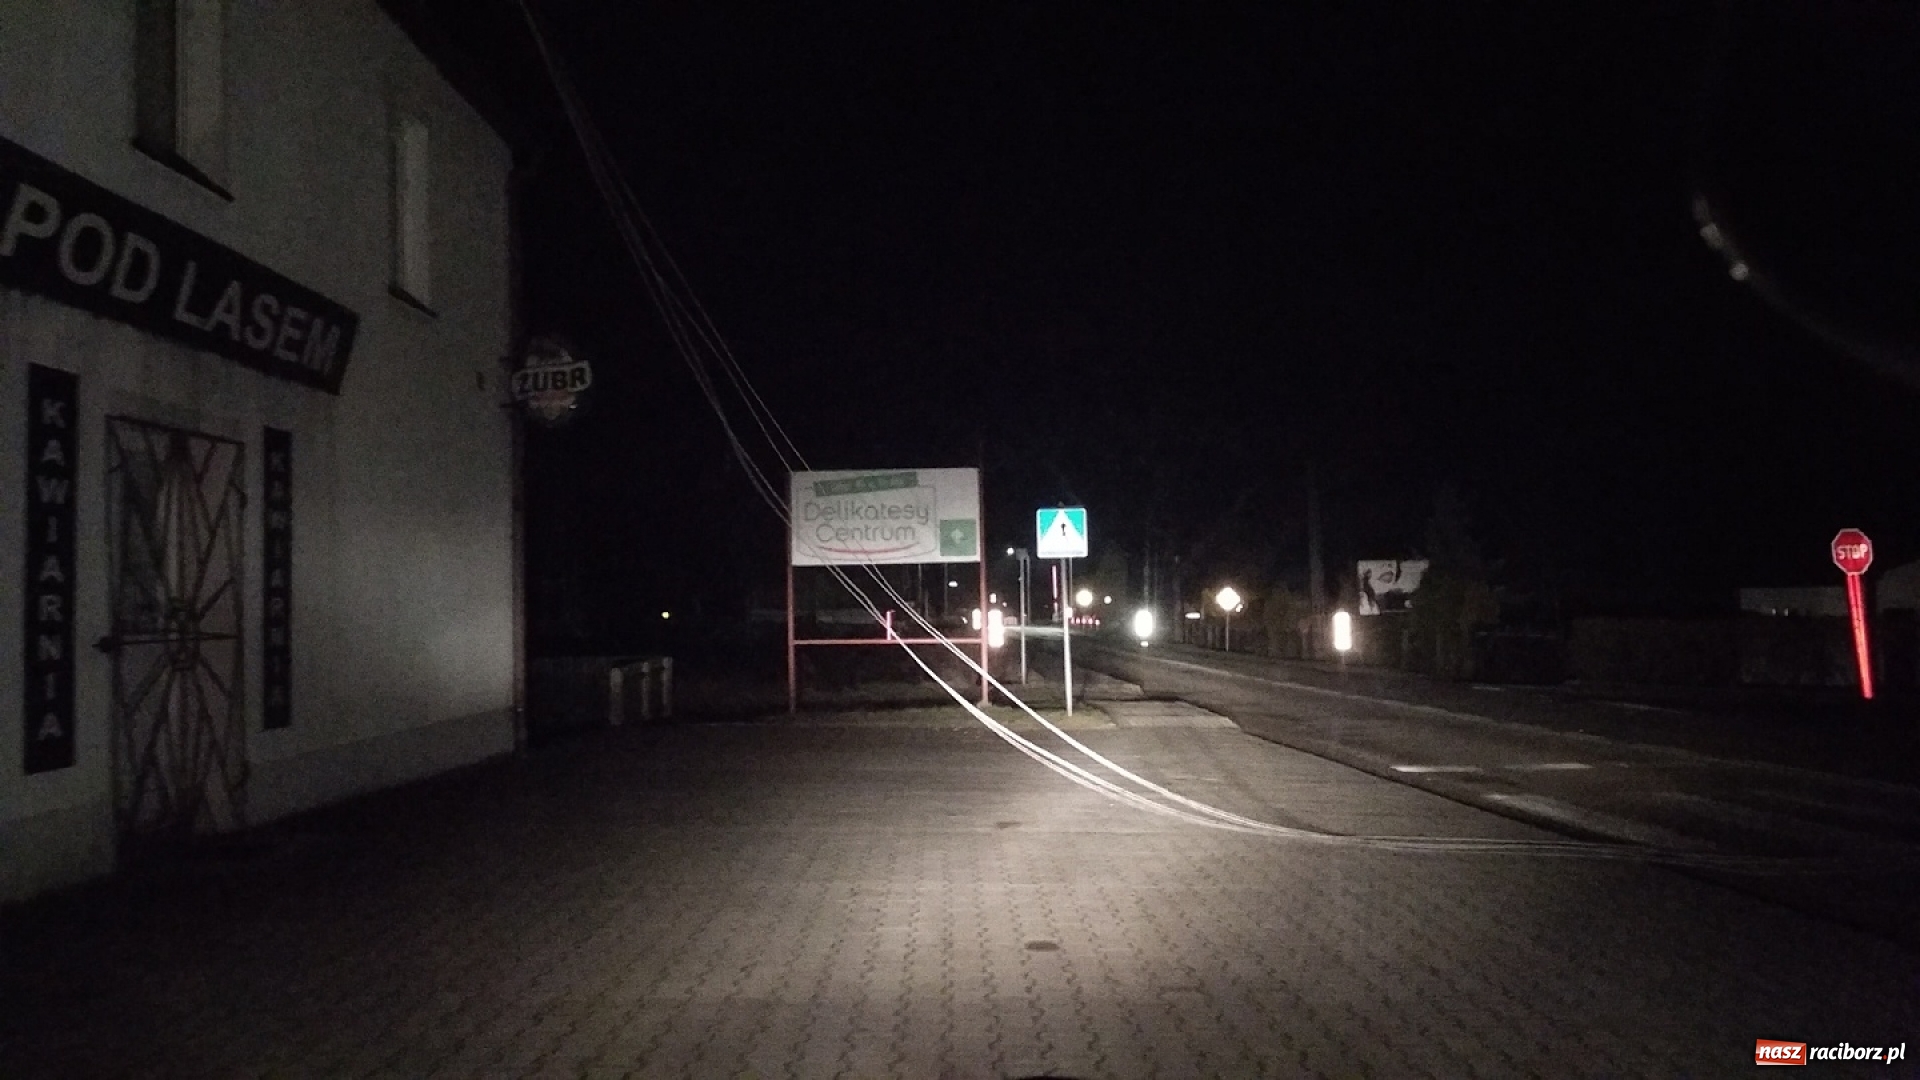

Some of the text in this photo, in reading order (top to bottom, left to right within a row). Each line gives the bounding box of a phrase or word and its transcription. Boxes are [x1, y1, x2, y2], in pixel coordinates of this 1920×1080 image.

[1, 182, 341, 377] POD LASEM
[804, 500, 929, 525] Delikatesy
[815, 523, 917, 542] Centrum
[1836, 543, 1869, 560] STOP
[36, 398, 70, 740] KAWIARNIA
